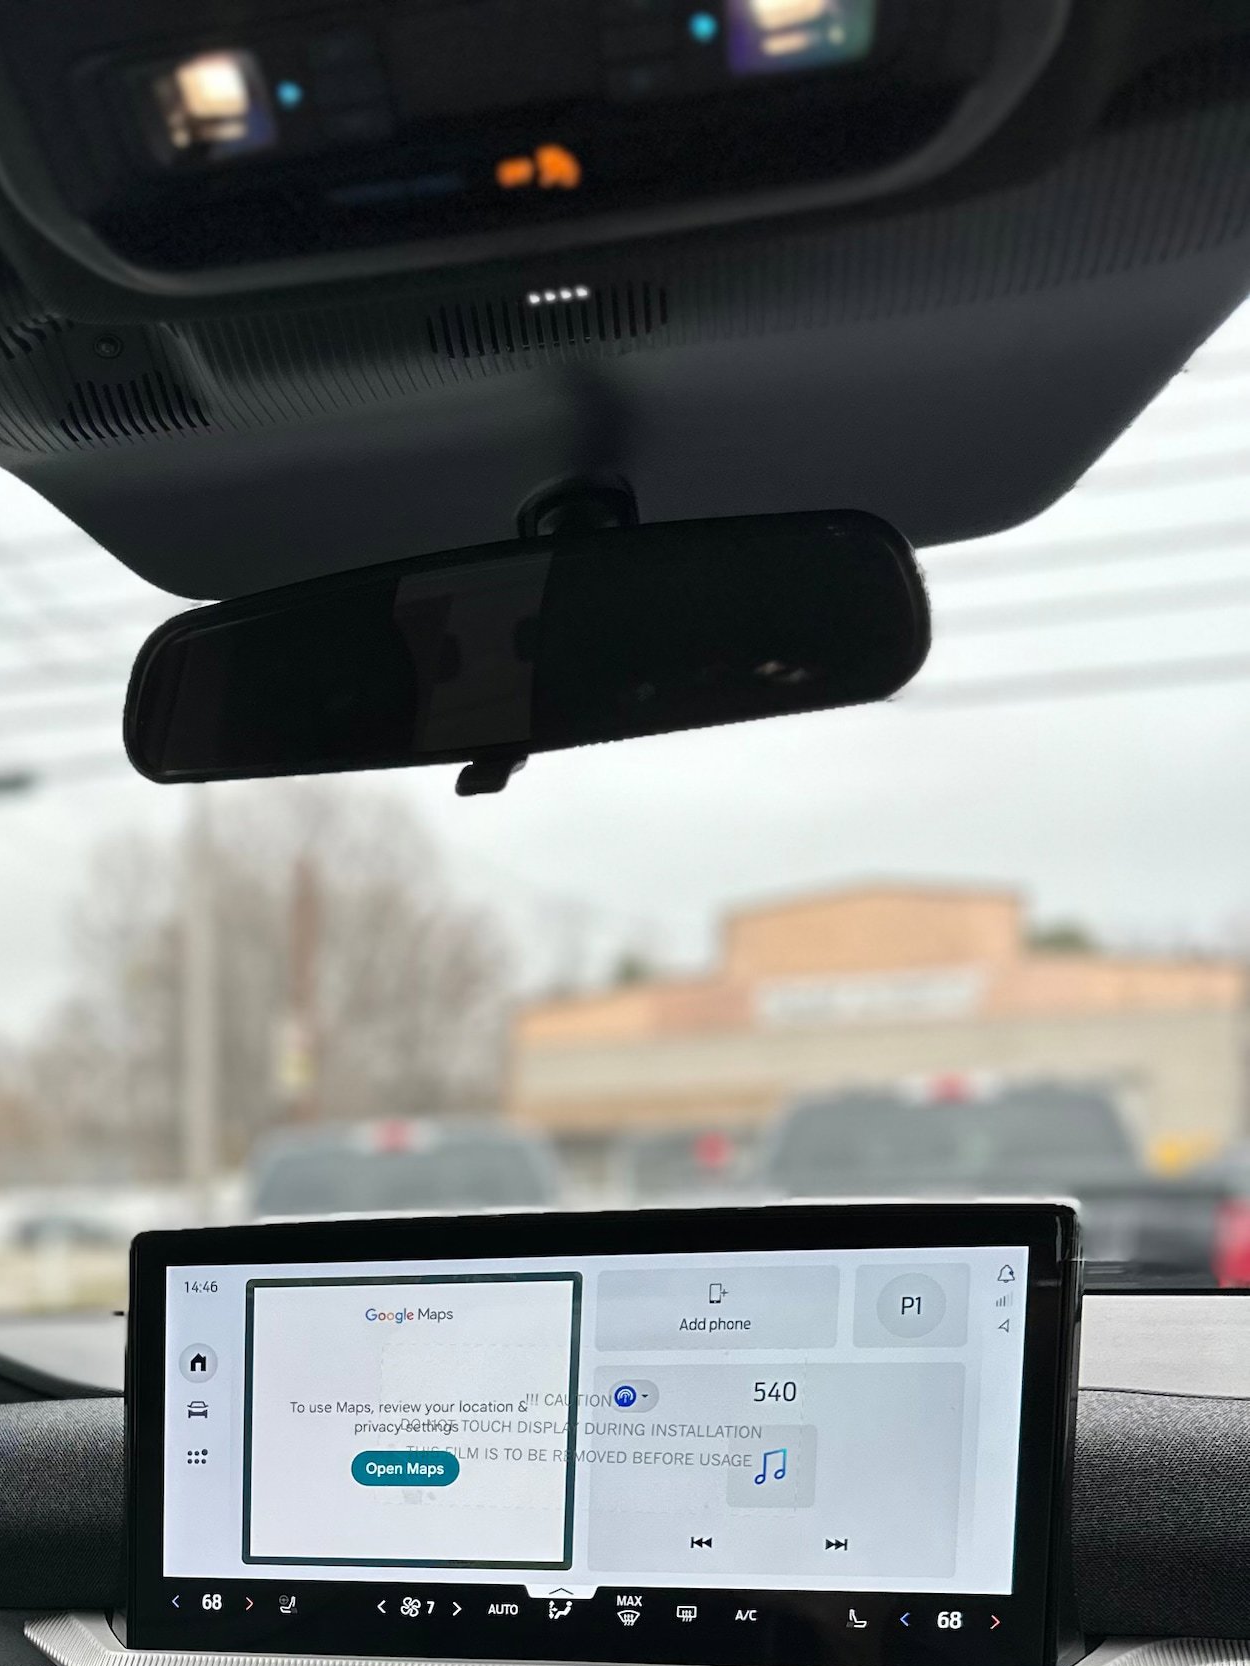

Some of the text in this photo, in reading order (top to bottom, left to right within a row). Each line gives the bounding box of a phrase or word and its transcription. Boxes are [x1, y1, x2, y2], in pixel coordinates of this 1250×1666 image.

[184, 1281, 218, 1293] 14:46
[901, 1296, 922, 1315] P1
[365, 1308, 453, 1324] Google Maps
[679, 1318, 751, 1333] Add phone
[753, 1381, 797, 1402] 540
[290, 1400, 528, 1416] To use Maps, review your location &
[544, 1393, 612, 1408] CAUTION
[354, 1420, 459, 1436] privacy settings
[401, 1418, 421, 1431] DO
[427, 1419, 454, 1432] NOT
[461, 1419, 512, 1433] TOUCH
[584, 1422, 645, 1436] DURING
[651, 1423, 762, 1439] INSTALLATION
[485, 1448, 498, 1460] IS
[504, 1448, 523, 1461] TO
[528, 1448, 548, 1462] BE
[552, 1449, 627, 1464] REMOVED
[632, 1452, 694, 1466] BEFORE
[699, 1453, 752, 1468] USAGE
[366, 1462, 445, 1477] Open Maps
[202, 1593, 223, 1611] 68
[426, 1601, 435, 1615] 7
[617, 1595, 642, 1607] MAX
[488, 1603, 519, 1616] AUTO
[735, 1609, 757, 1622] A/C
[936, 1611, 963, 1630] 68
